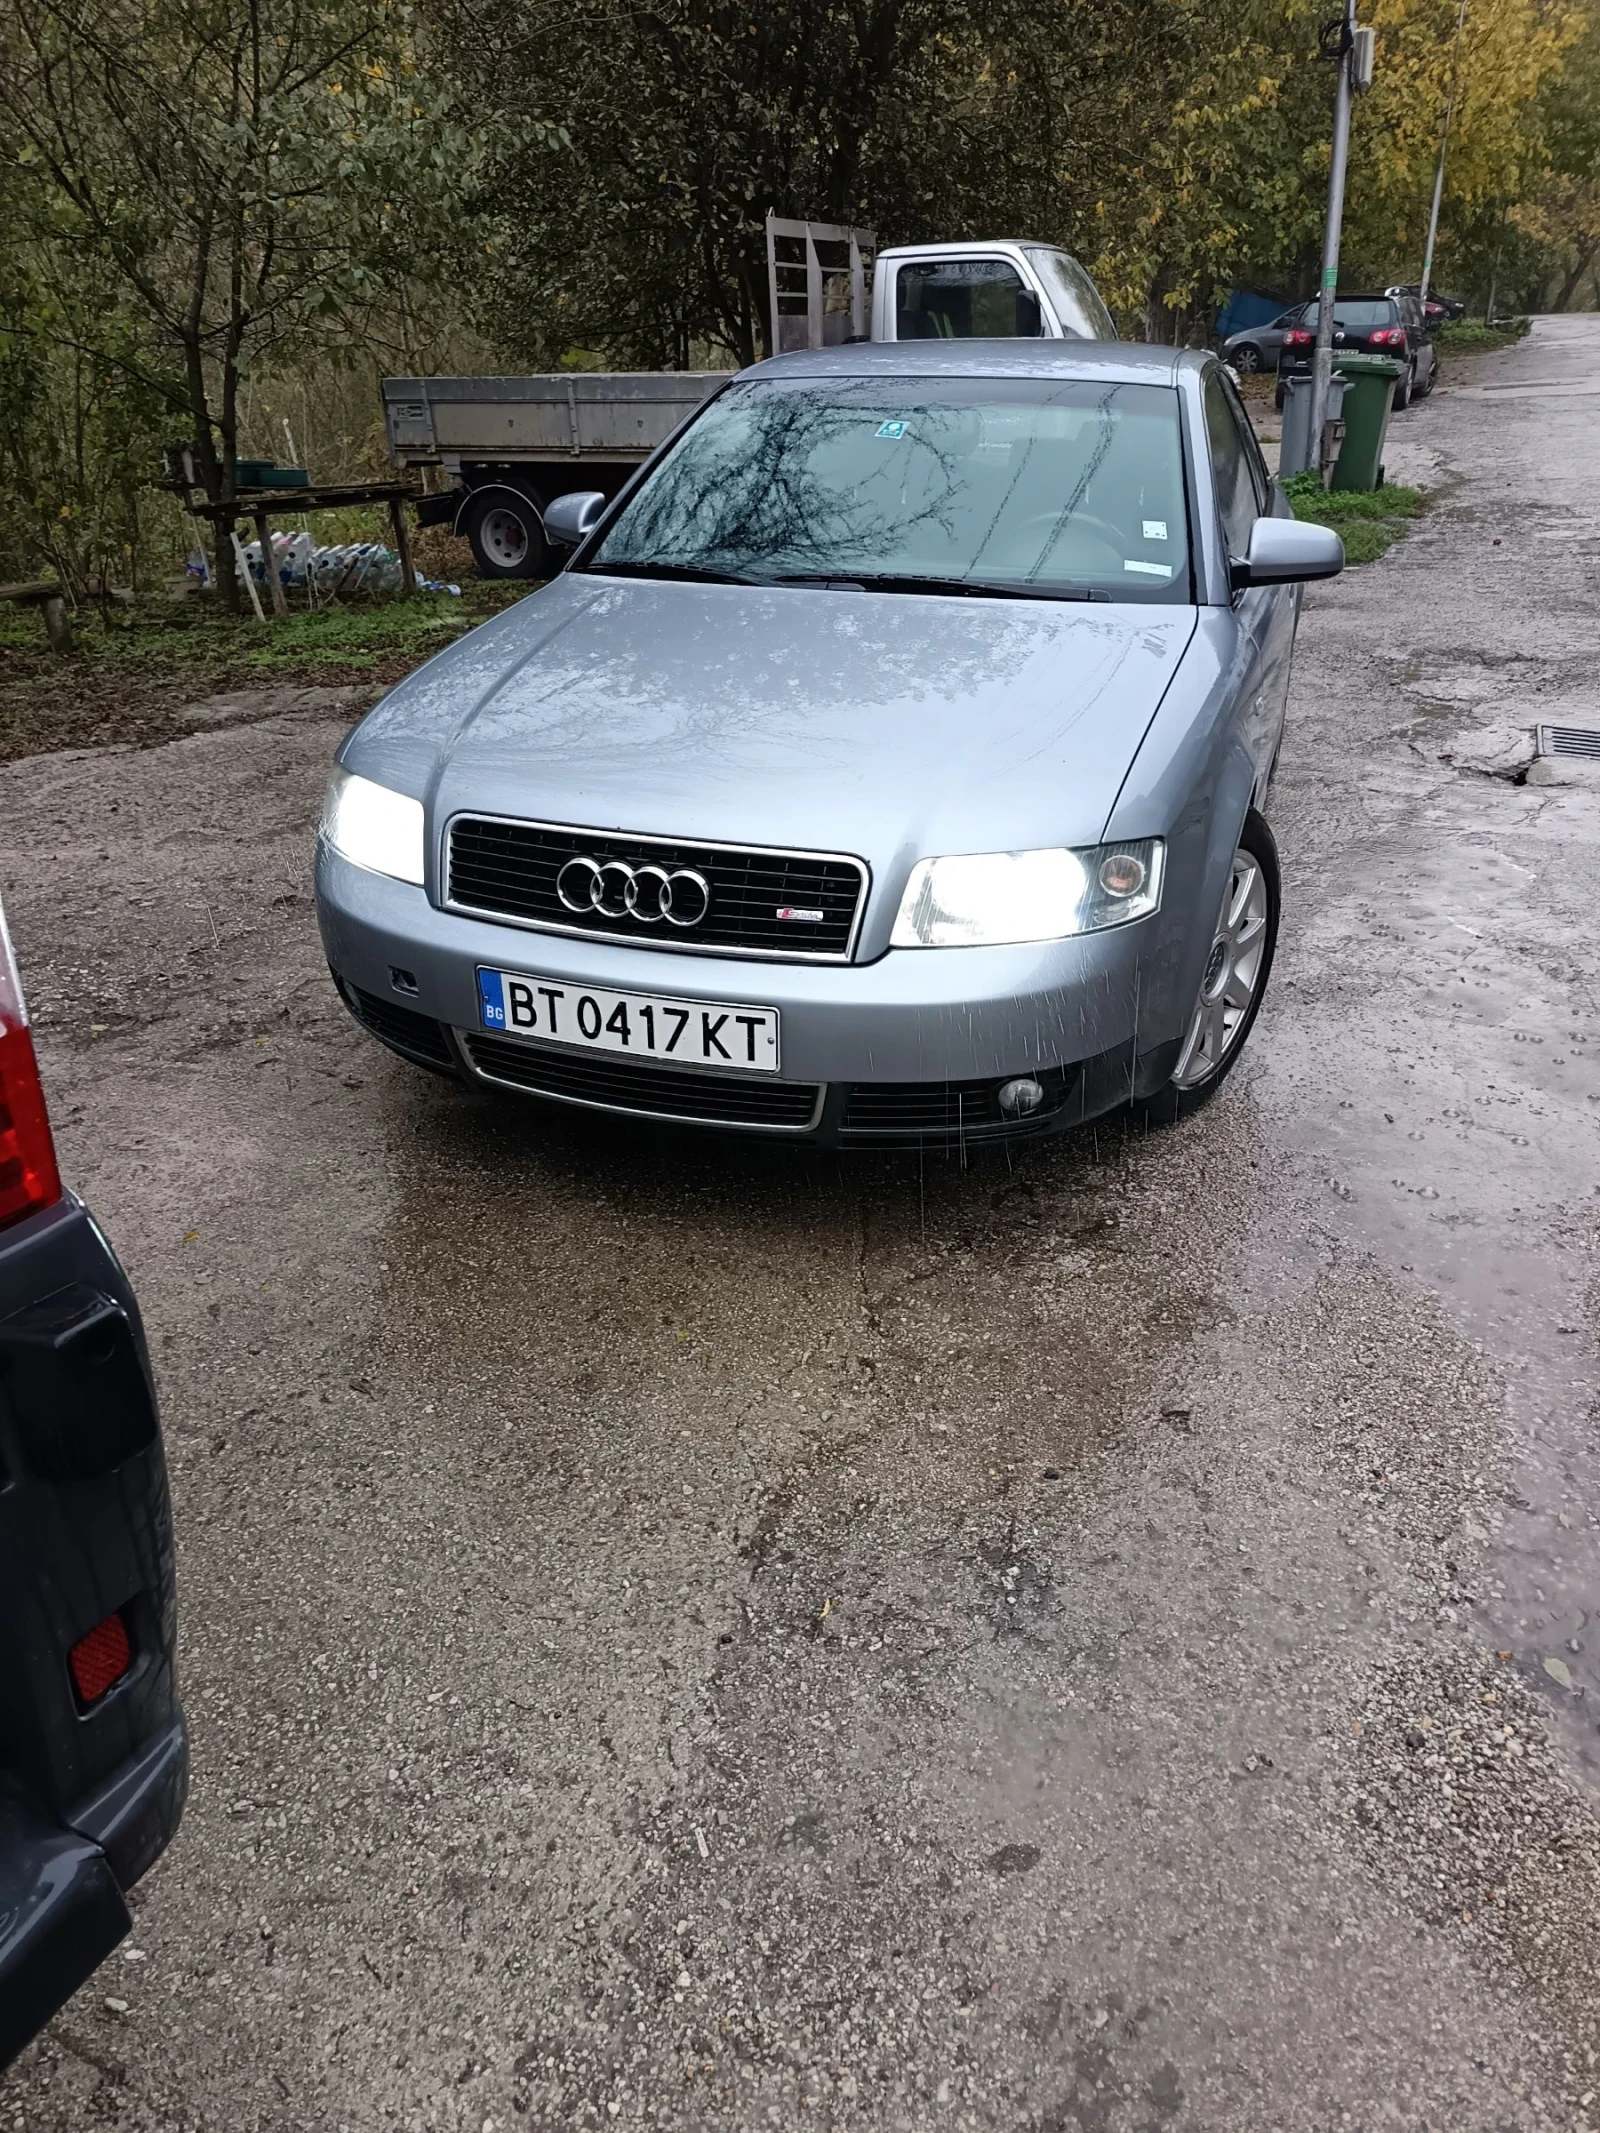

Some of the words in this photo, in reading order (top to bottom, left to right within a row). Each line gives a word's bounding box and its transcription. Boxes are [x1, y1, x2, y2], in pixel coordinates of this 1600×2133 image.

[486, 1004, 504, 1020] BG
[508, 981, 564, 1033] BT
[577, 995, 689, 1052] 0417
[701, 1012, 766, 1061] KT
